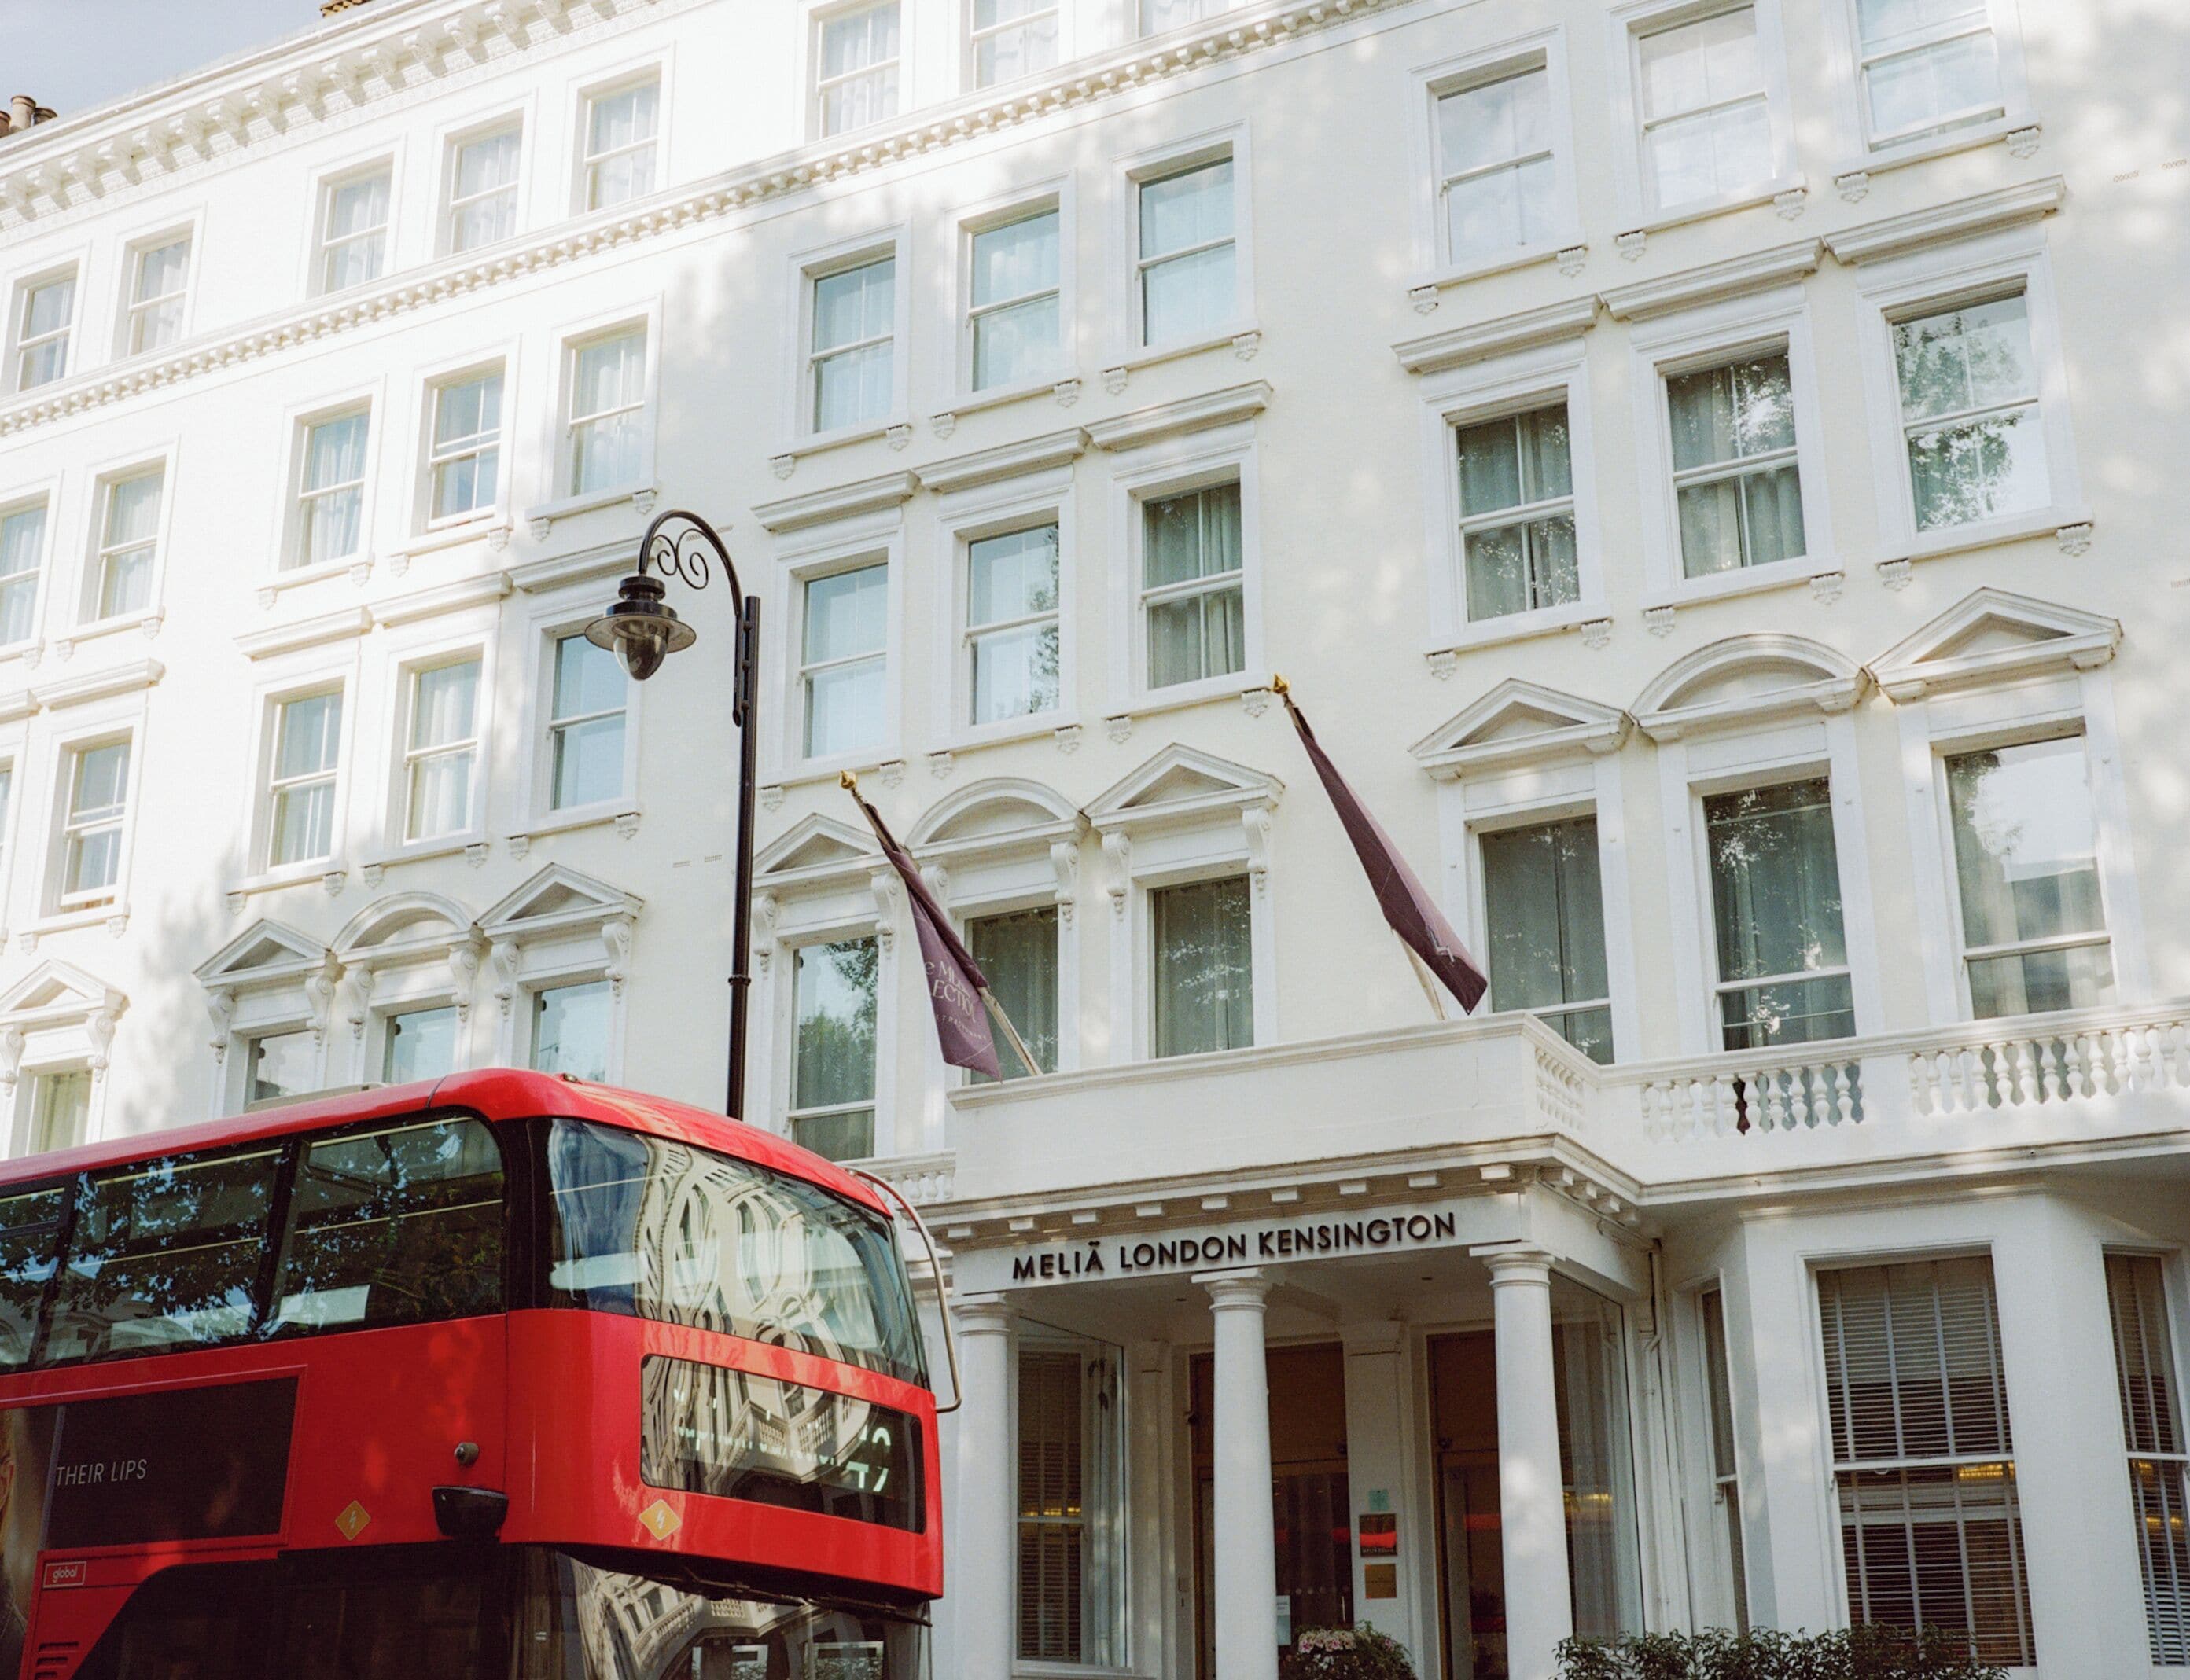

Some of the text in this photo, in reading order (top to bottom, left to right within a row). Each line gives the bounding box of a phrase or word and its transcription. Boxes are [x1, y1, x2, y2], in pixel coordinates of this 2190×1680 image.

[1120, 1233, 1246, 1269] LONDON
[1258, 1212, 1456, 1255] KENSINGTON
[57, 1458, 148, 1487] THEIR LIPS
[53, 1565, 79, 1583] global
